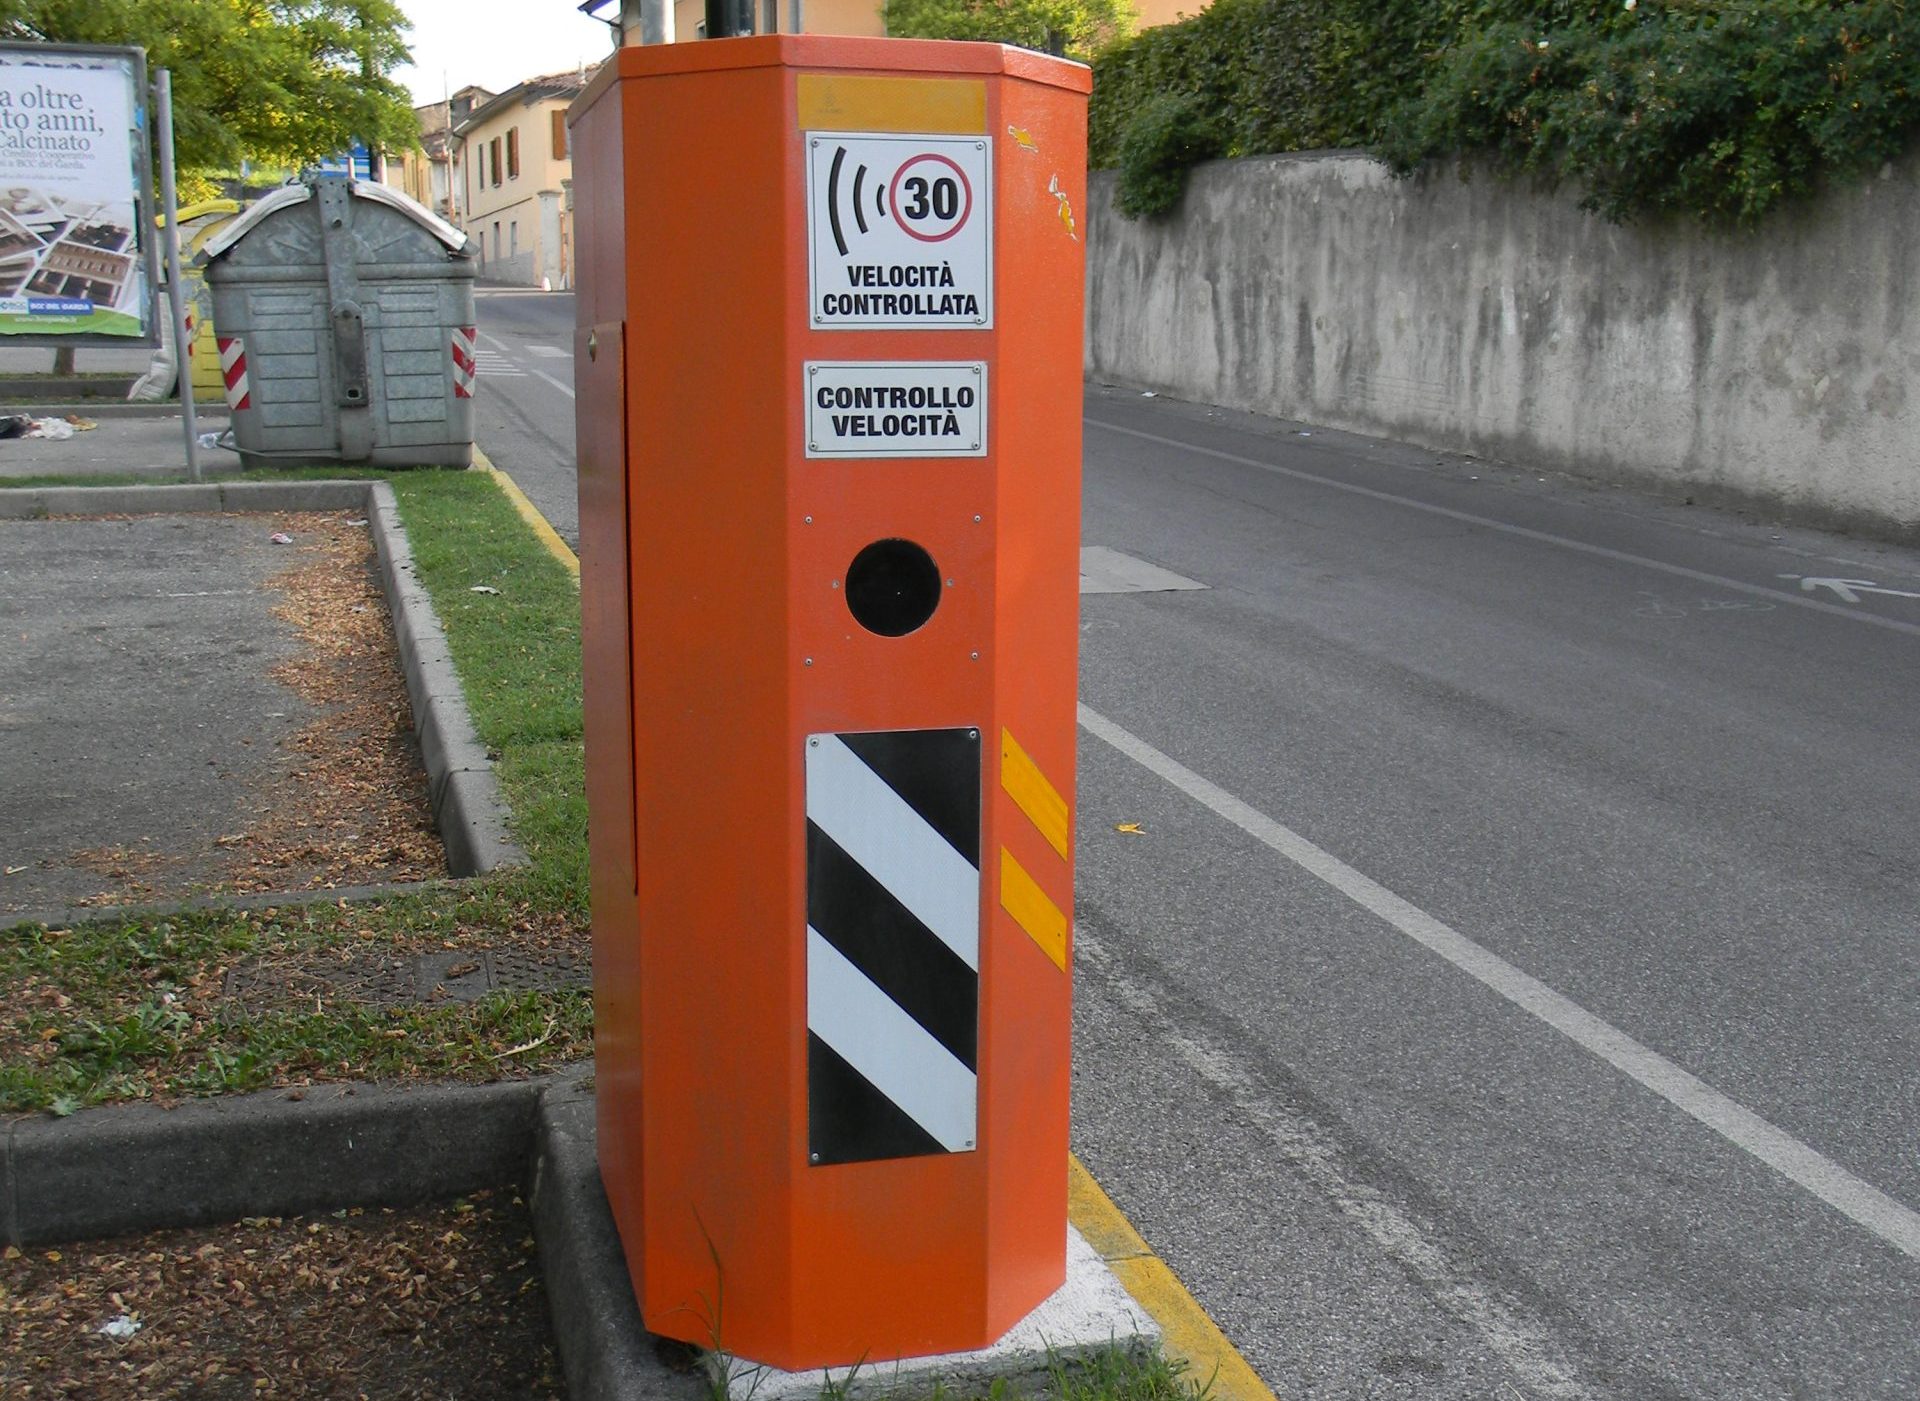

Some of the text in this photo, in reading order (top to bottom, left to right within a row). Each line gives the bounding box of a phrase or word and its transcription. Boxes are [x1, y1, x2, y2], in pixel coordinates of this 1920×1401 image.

[21, 84, 84, 110] oltre
[0, 109, 104, 137] to anni,
[904, 177, 958, 220] 30
[847, 261, 955, 288] VELOCITÀ
[62, 303, 91, 311] GARDA
[823, 293, 979, 316] CONTROLLATA
[817, 386, 975, 409] CONTROLLO
[832, 409, 961, 437] VELOCITÀ
